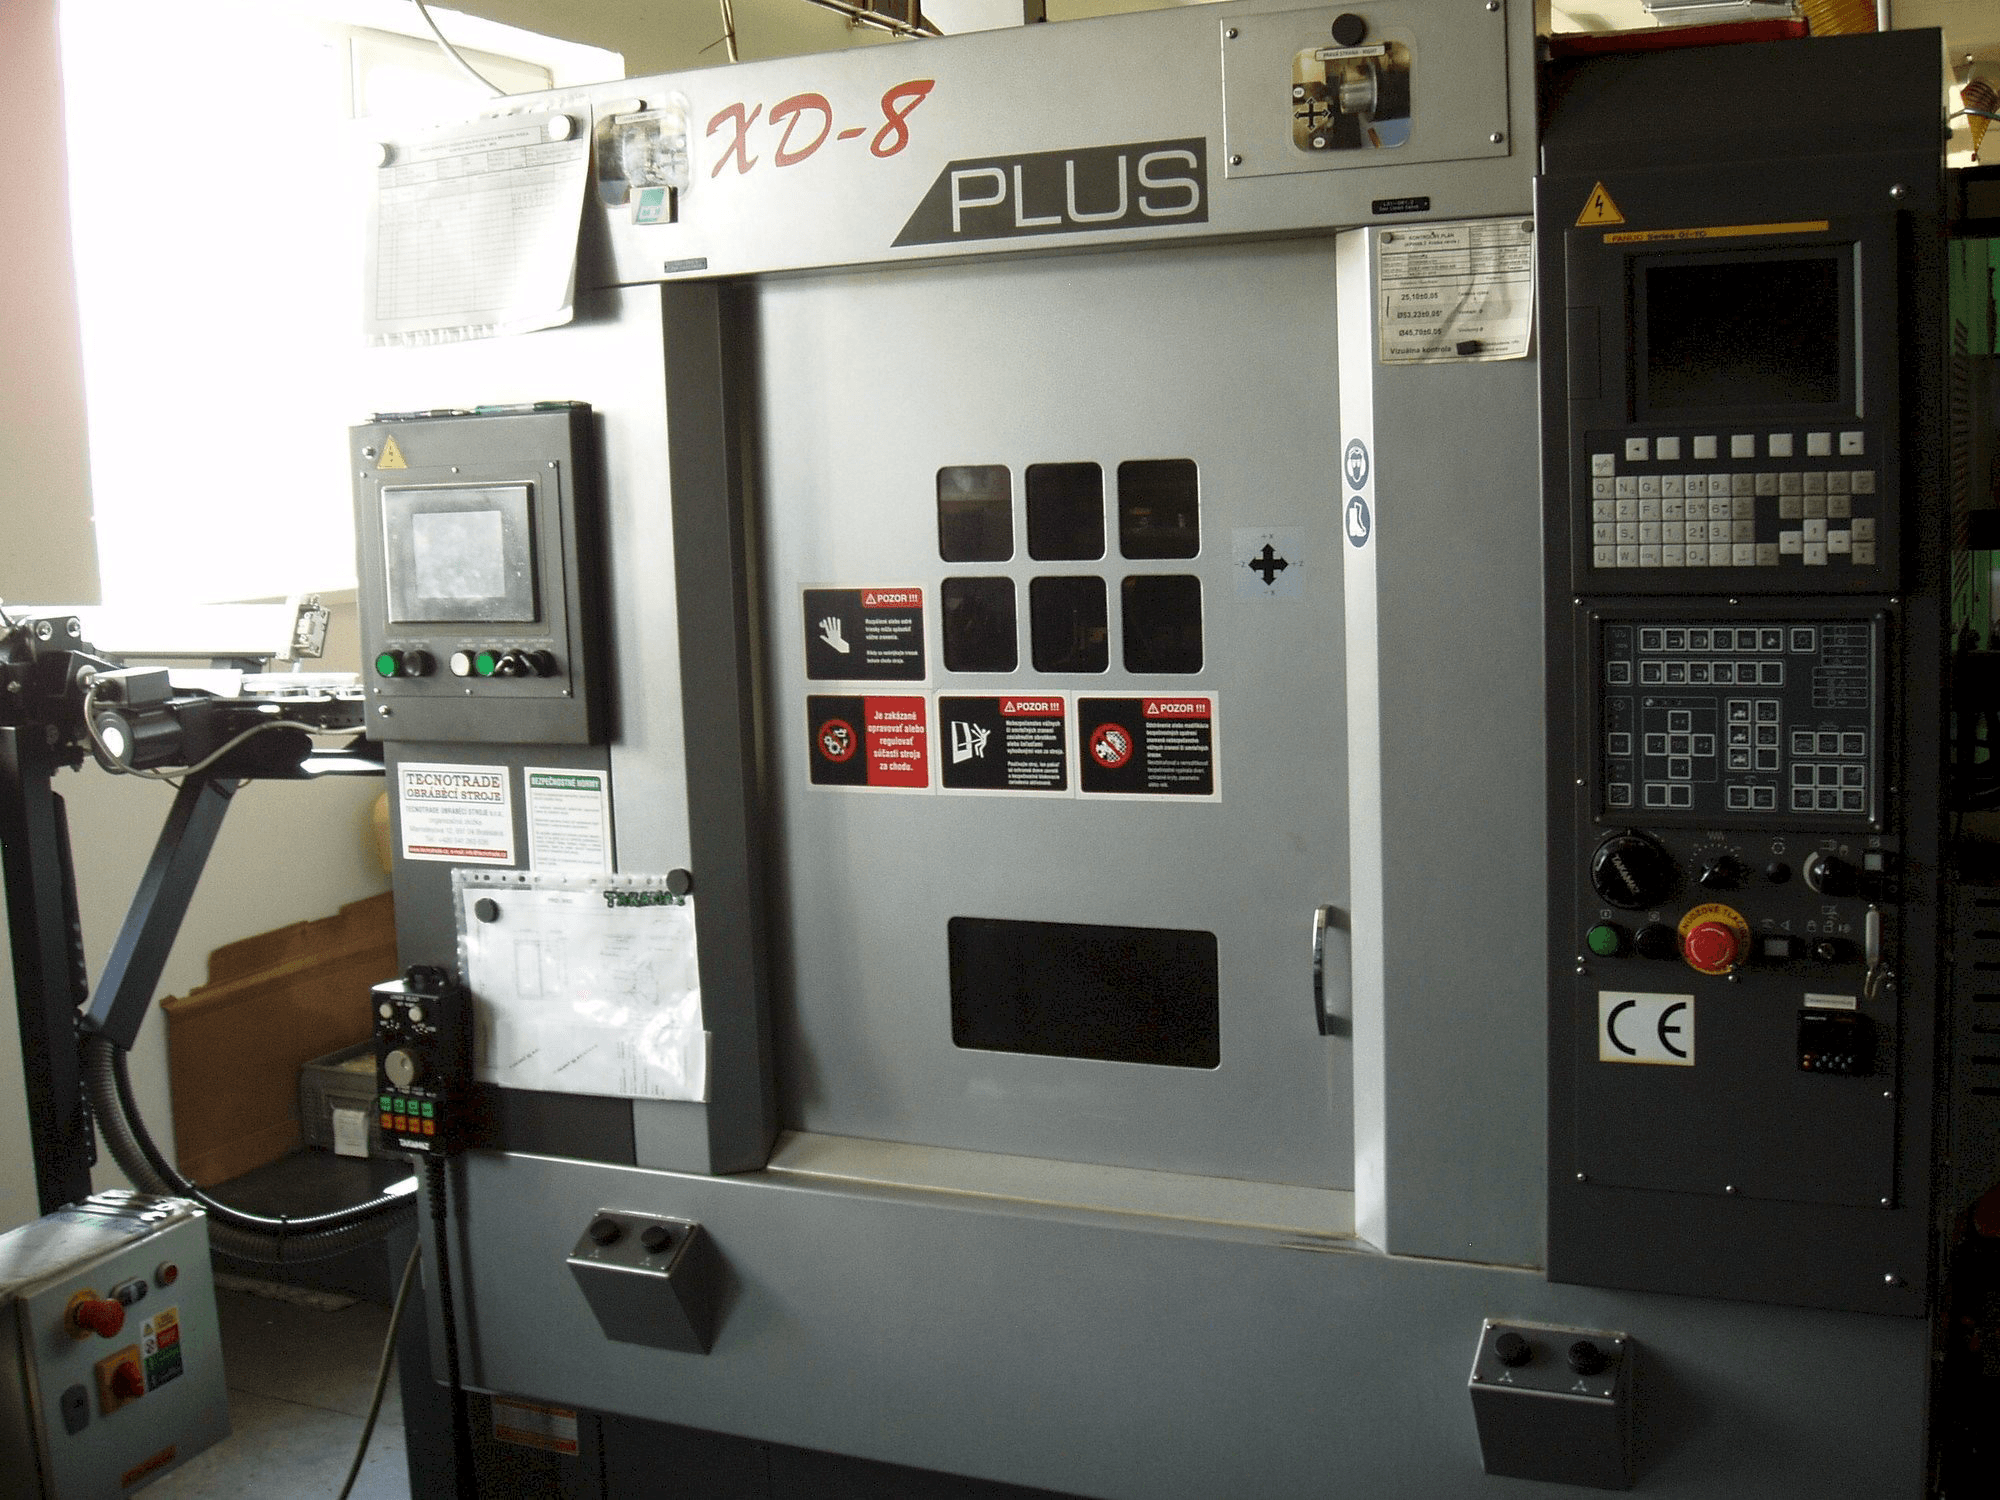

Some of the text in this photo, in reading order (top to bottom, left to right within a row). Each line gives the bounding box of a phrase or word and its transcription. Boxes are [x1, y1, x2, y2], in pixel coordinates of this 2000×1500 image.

[706, 78, 936, 179] XD-8
[950, 150, 1201, 233] PLUS
[877, 594, 918, 603] POZOR !!!
[1016, 702, 1060, 711] POZOR !!!
[1160, 704, 1206, 712] POZOR !!!
[874, 710, 917, 720] Je zakázané
[868, 724, 924, 734] opravovať alebo
[406, 773, 500, 788] TECNOTRADE
[461, 791, 501, 801] STROJE
[1606, 999, 1687, 1059] CE
